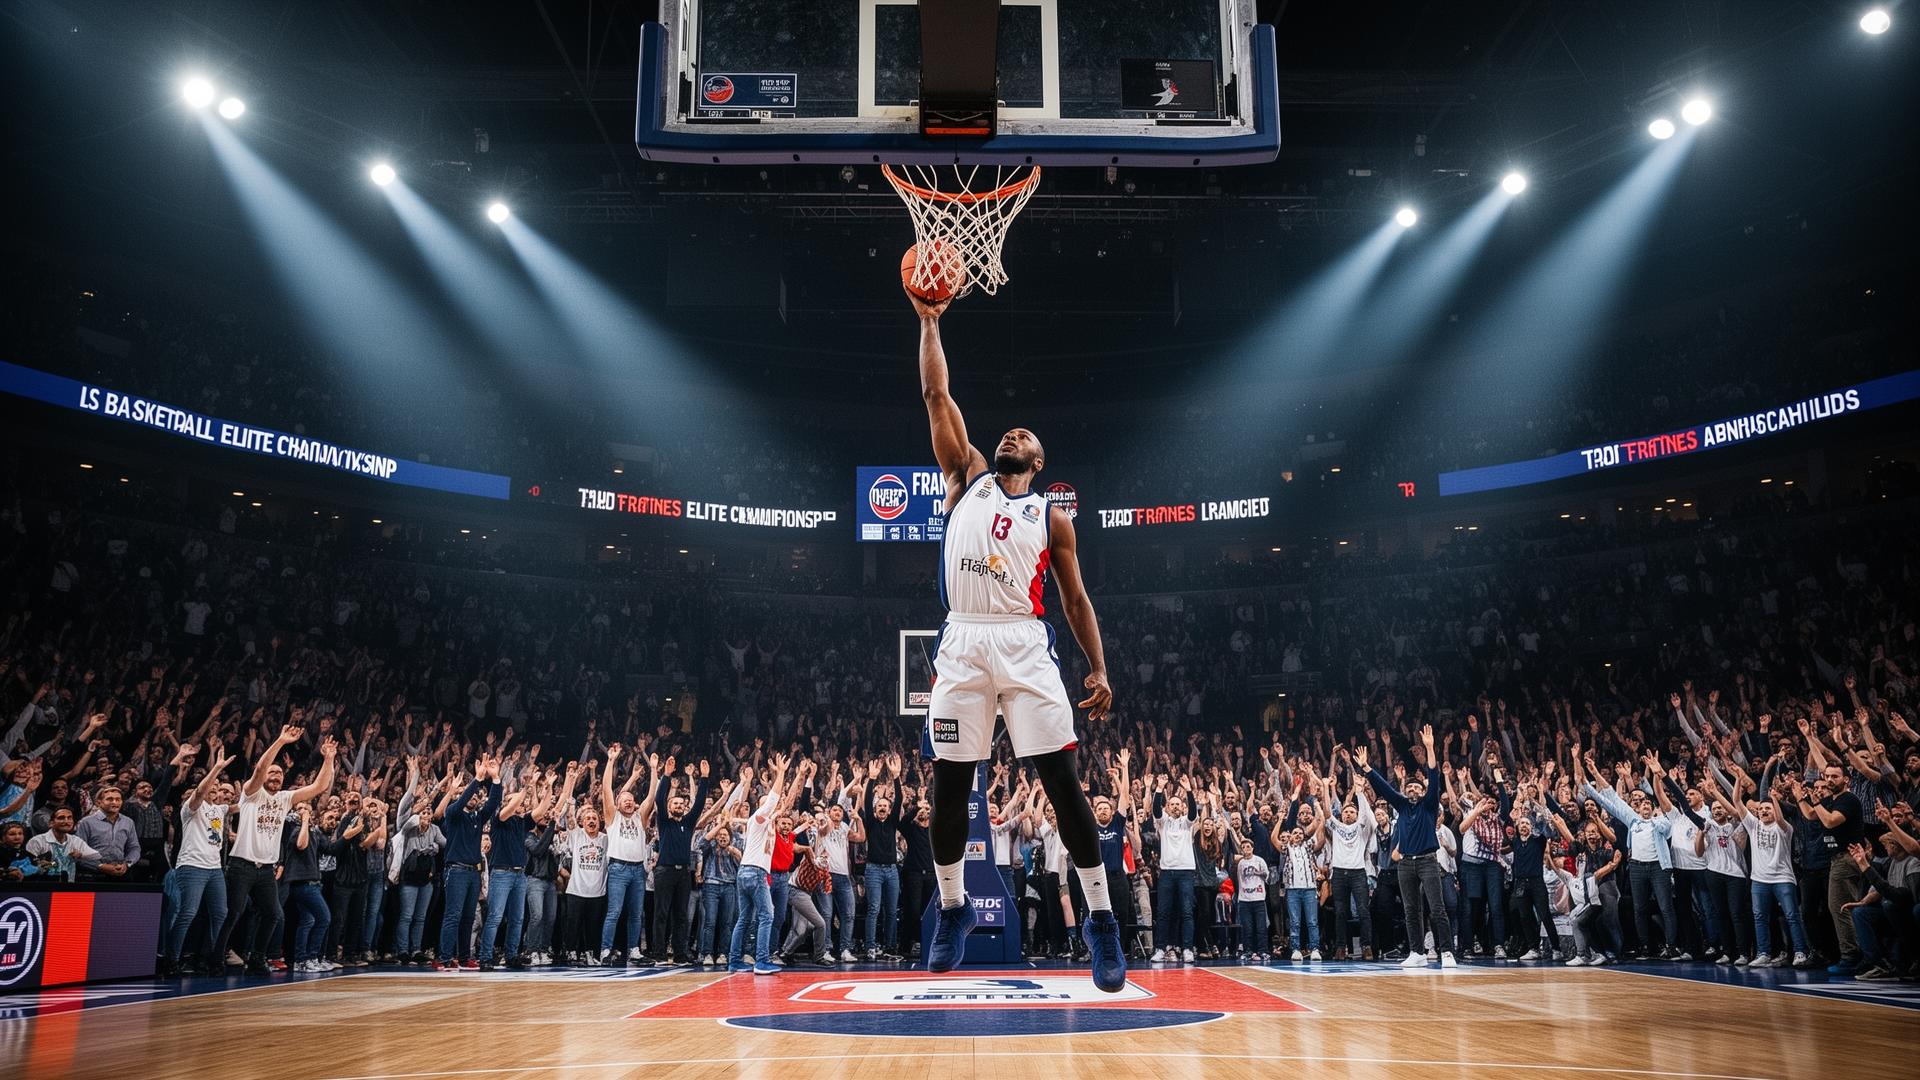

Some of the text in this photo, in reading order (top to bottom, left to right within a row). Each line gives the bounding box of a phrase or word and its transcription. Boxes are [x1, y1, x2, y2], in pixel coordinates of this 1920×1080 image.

[80, 386, 100, 411] LS
[686, 500, 728, 522] ELITE
[991, 513, 1012, 541] 13
